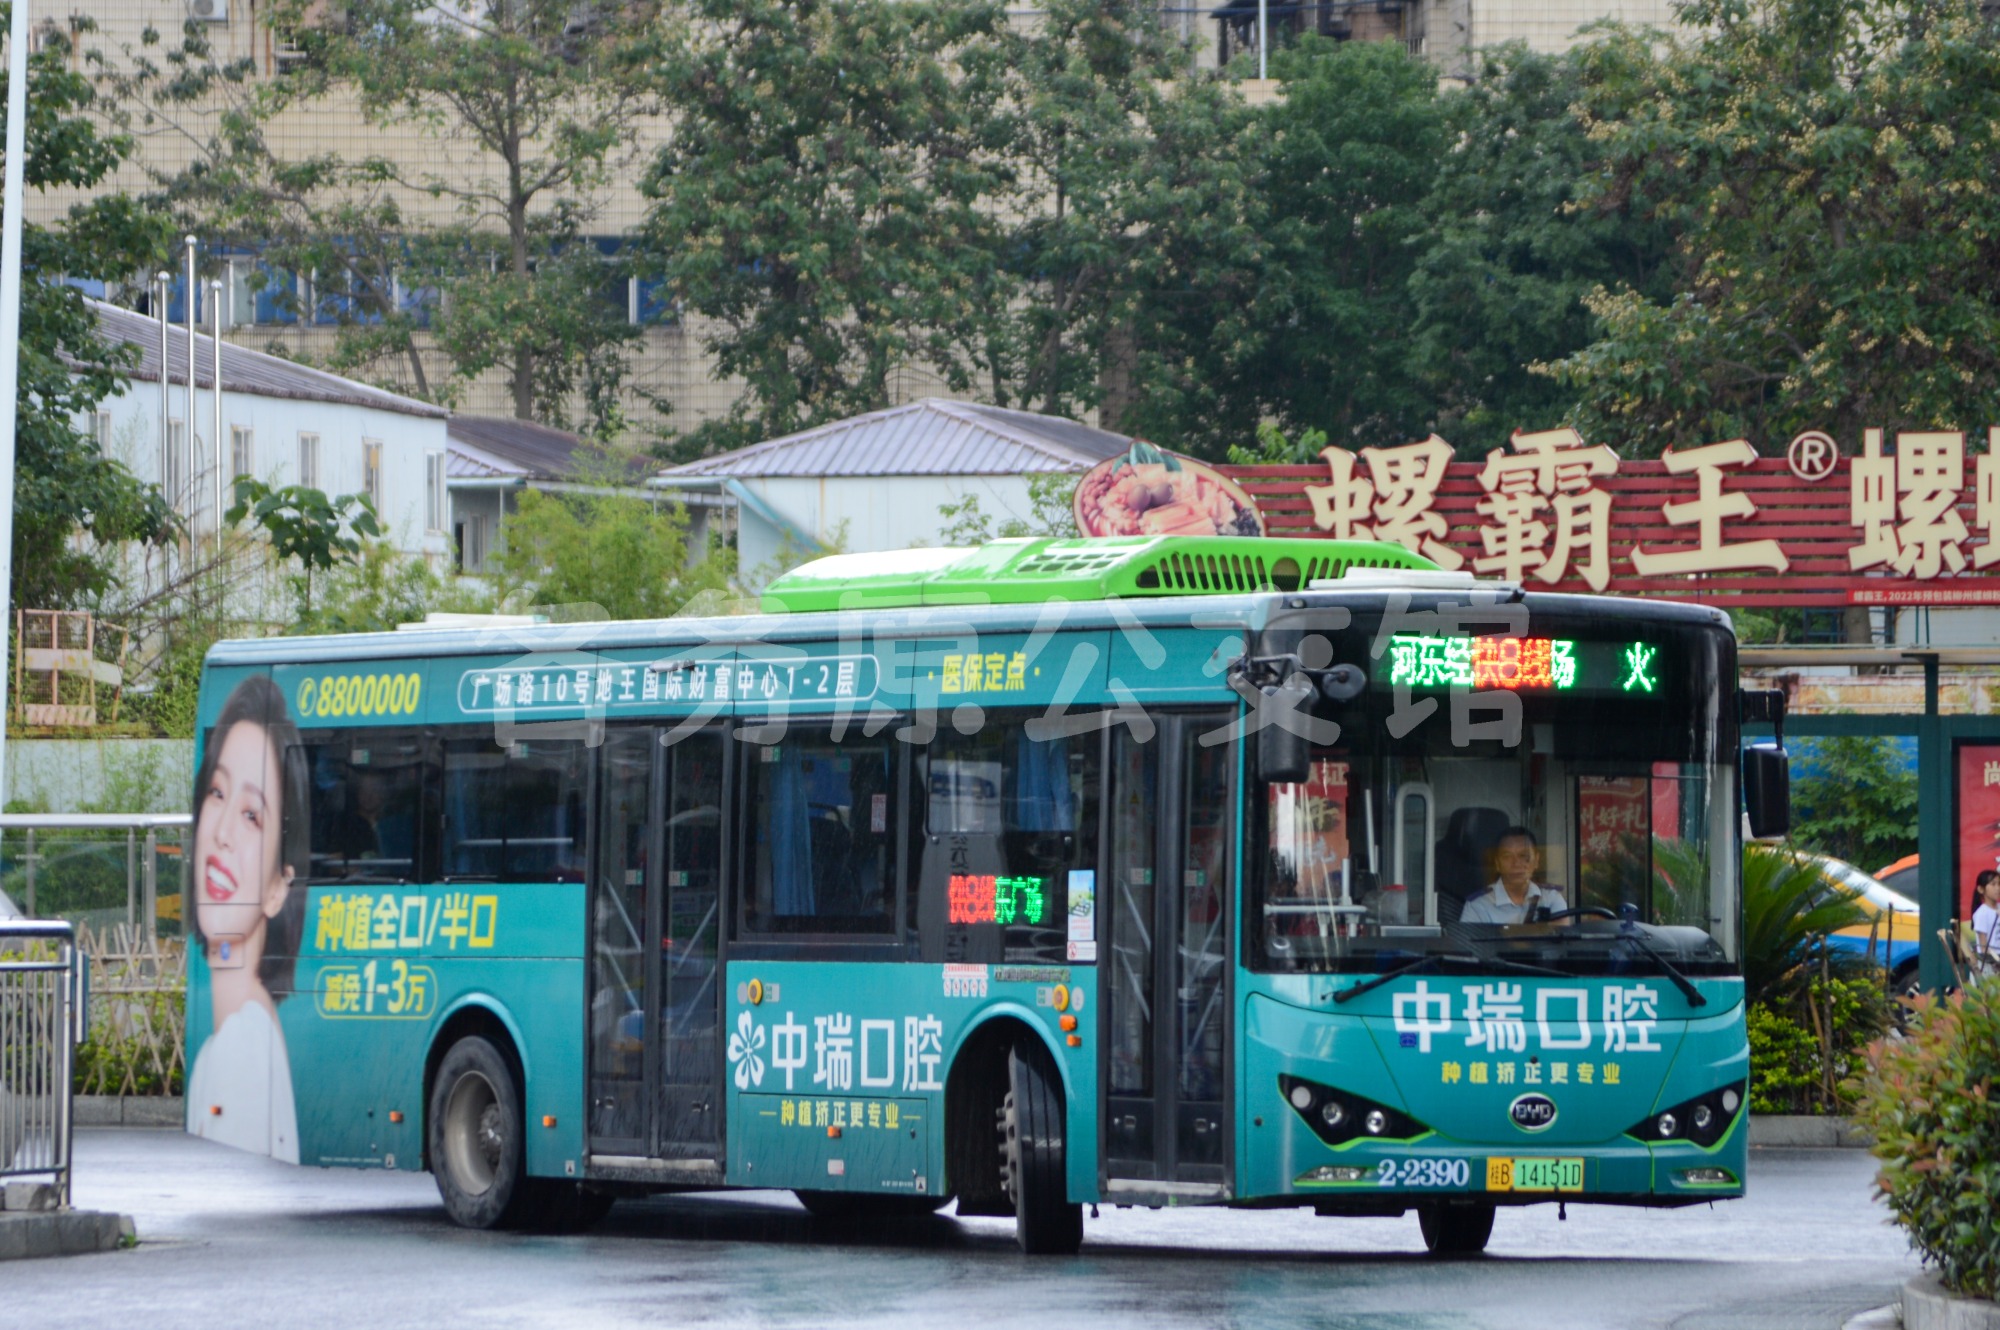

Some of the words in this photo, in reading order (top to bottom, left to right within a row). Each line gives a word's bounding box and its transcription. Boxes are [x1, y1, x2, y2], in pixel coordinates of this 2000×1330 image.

[316, 674, 421, 716] 8800000
[314, 892, 498, 952] 种植全口/半口
[323, 959, 427, 1014] 减免1-3万
[1392, 981, 1662, 1053] 中瑞口腔
[771, 1010, 943, 1092] 中瑞口腔
[1441, 1062, 1621, 1085] 种植矫正更专业
[780, 1101, 900, 1130] 种植矫正更专业
[1377, 1158, 1470, 1187] 2-2390
